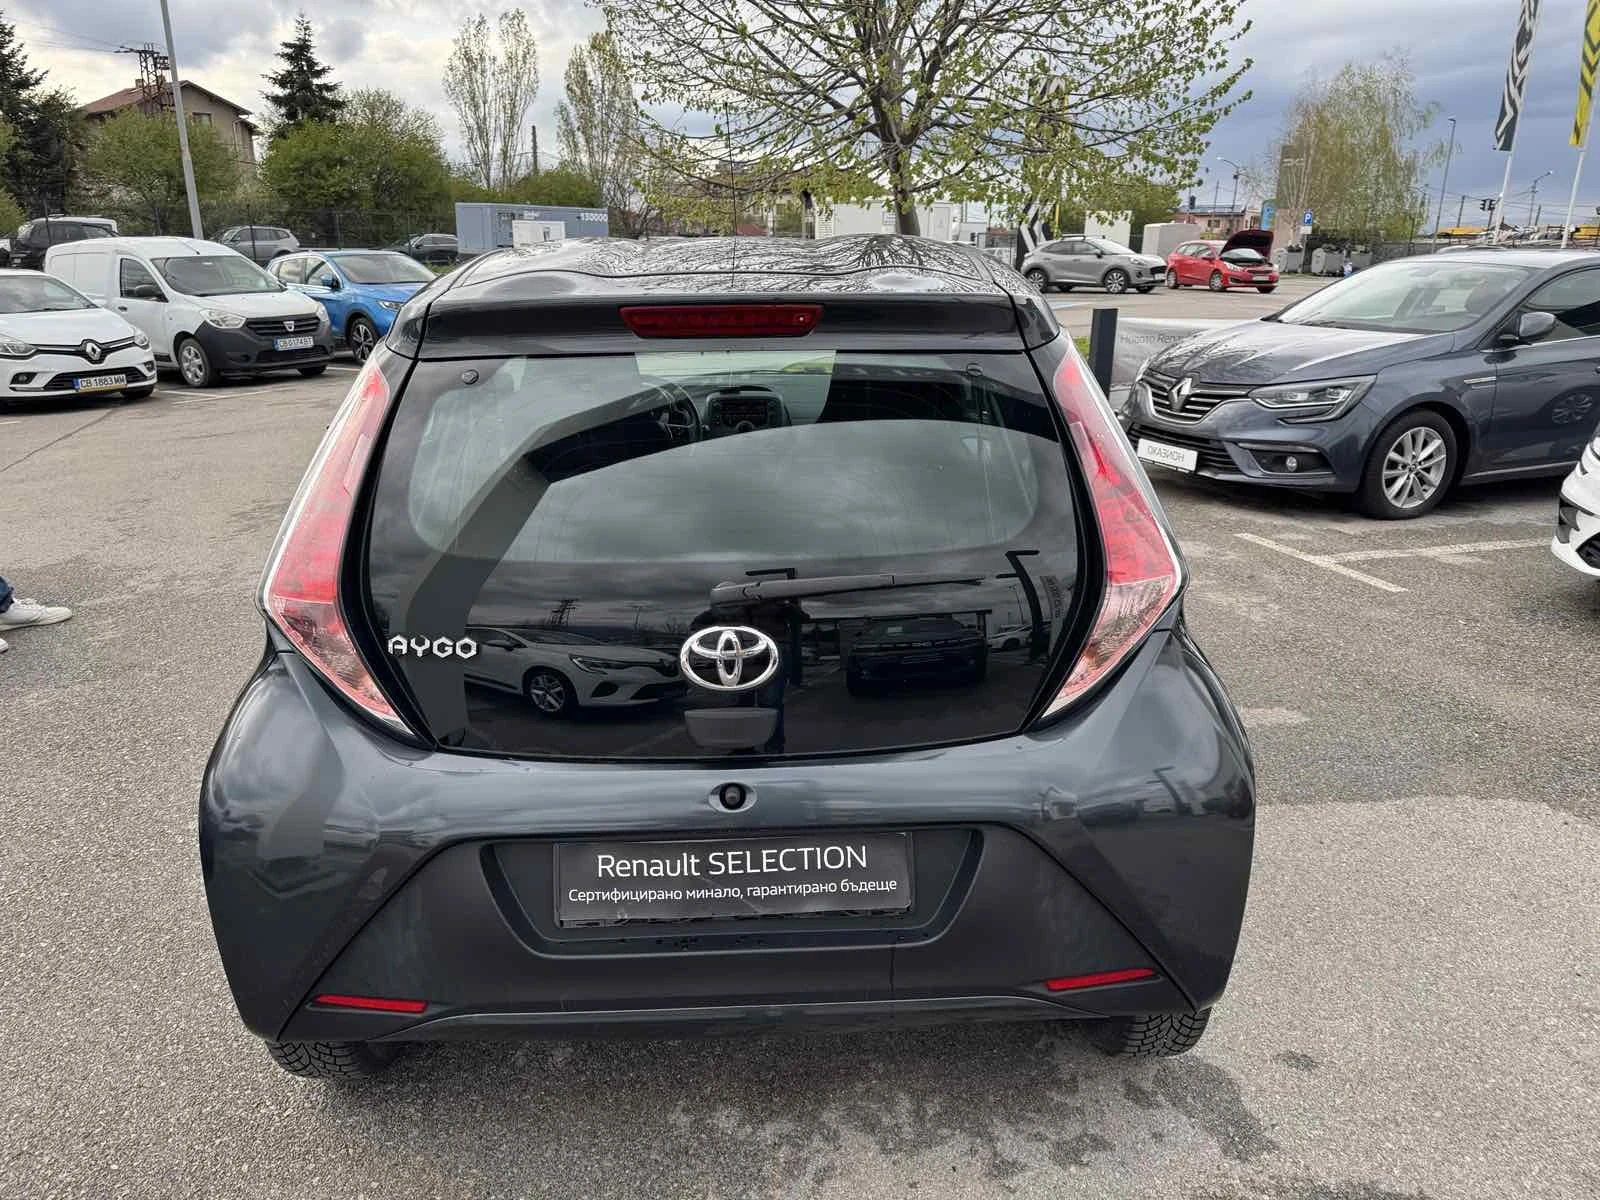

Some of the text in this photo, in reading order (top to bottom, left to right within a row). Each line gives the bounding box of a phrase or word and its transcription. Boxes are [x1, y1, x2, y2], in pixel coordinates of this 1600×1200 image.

[388, 634, 477, 659] AYGO
[597, 845, 867, 878] Renault SELECTION
[568, 879, 897, 904] Сертифицирано минало, гарантирано бъдеще
